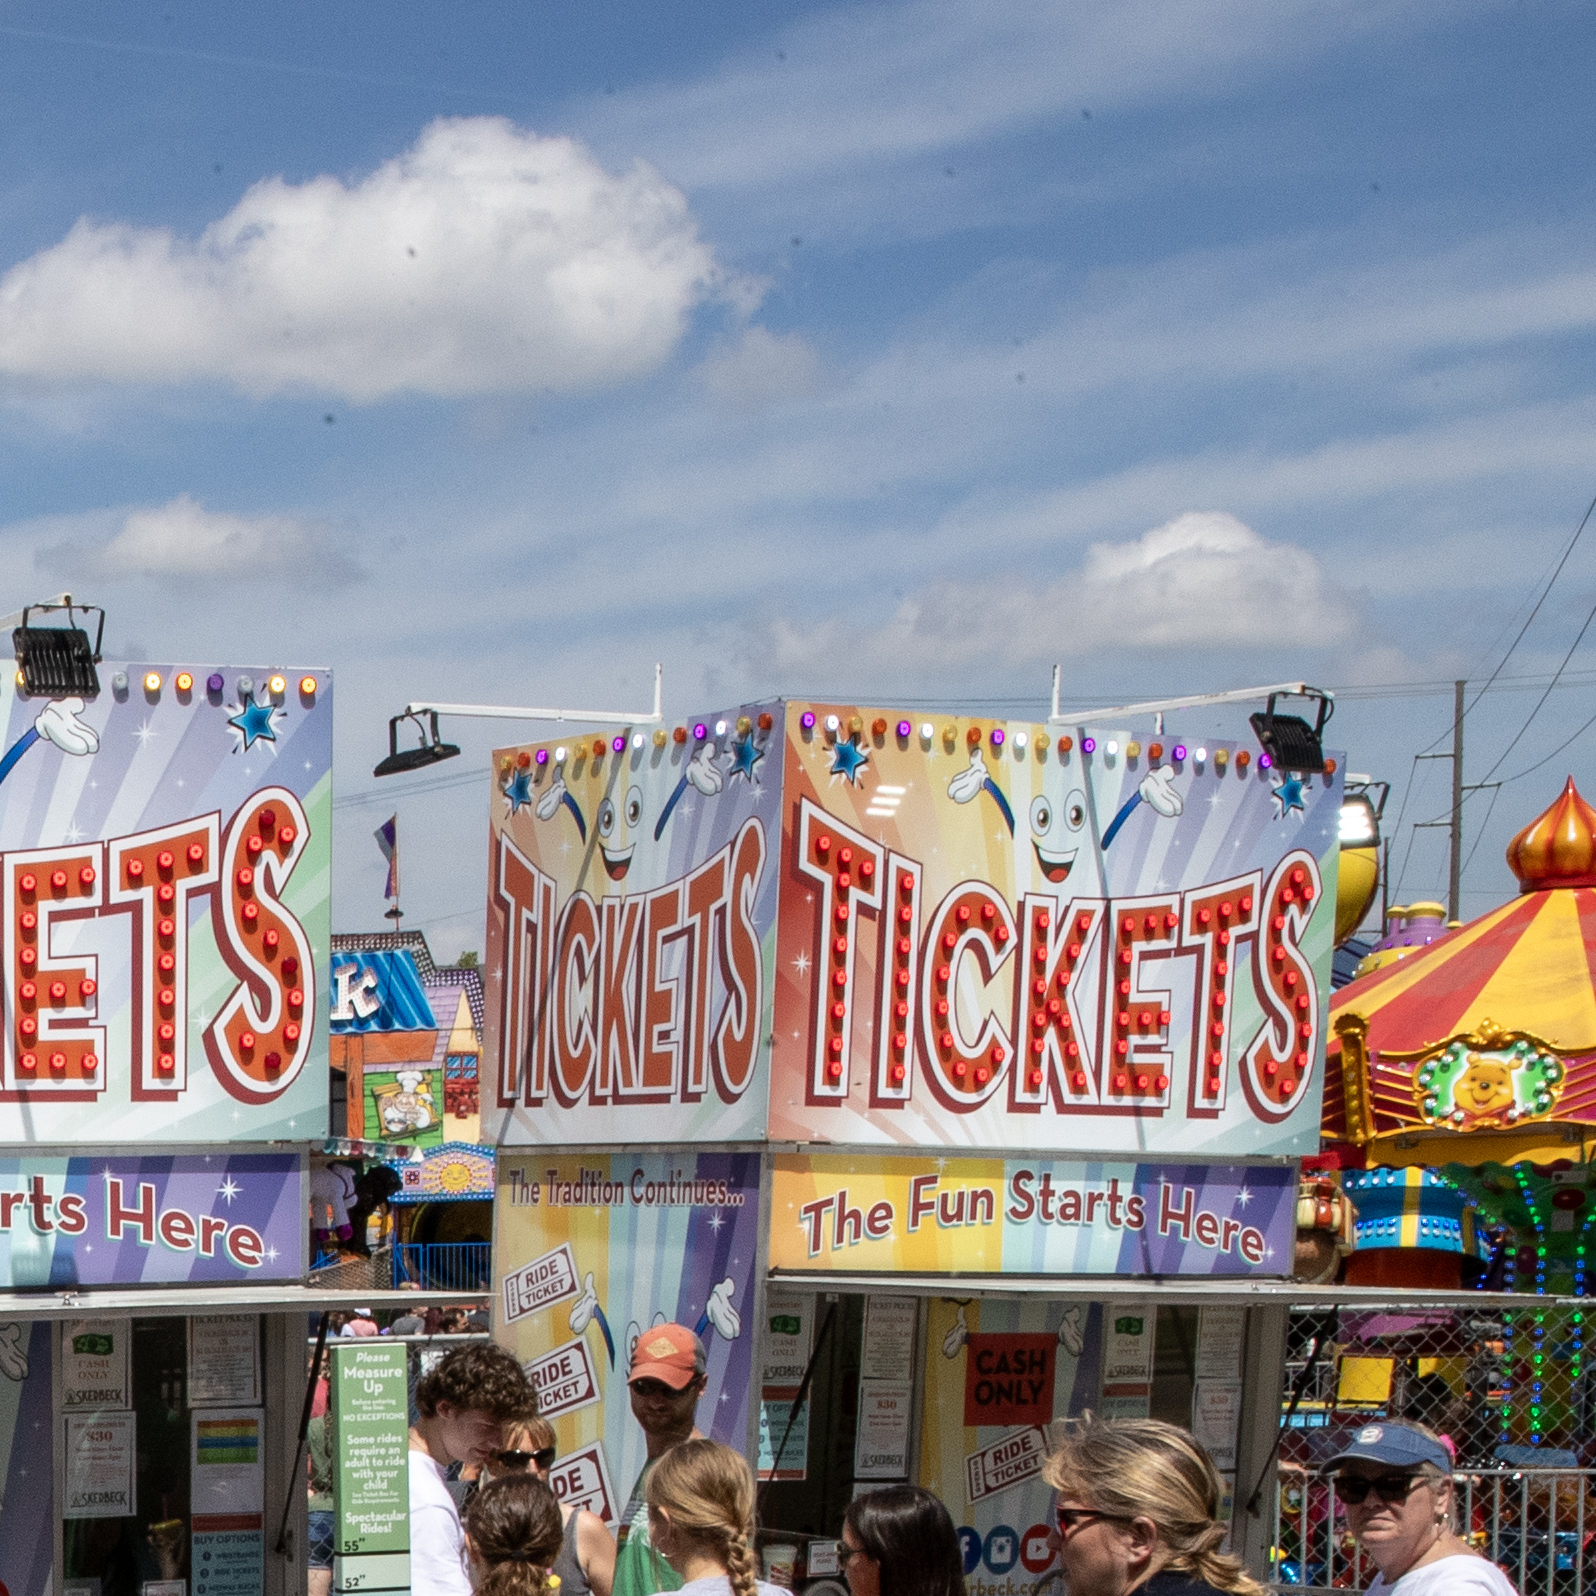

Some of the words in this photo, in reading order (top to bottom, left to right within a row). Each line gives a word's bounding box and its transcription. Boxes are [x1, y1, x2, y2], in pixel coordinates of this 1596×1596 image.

[492, 816, 767, 1110] TICKETS
[791, 796, 1325, 1122] TICKETS
[509, 1170, 540, 1206] The
[546, 1167, 625, 1206] Tradition
[630, 1168, 746, 1207] Continues...
[108, 1176, 266, 1268] Here
[803, 1195, 894, 1259] The
[907, 1173, 995, 1235] Fun
[1006, 1169, 1144, 1231] Starts
[1156, 1180, 1266, 1265] Here
[525, 1259, 560, 1288] RIDE
[524, 1279, 565, 1306] TICKET
[78, 1360, 110, 1369] CASH
[356, 1352, 391, 1364] Please
[976, 1349, 1048, 1376] CASH
[78, 1370, 110, 1380] ONLY
[343, 1366, 403, 1380] Measure
[531, 1355, 574, 1388] RIDE
[75, 1388, 123, 1404] SKERBECK
[363, 1380, 384, 1396] Up
[539, 1380, 580, 1406] ICKET
[975, 1377, 1049, 1409] ONLY
[343, 1413, 356, 1422] NO
[356, 1412, 406, 1422] EXCEPTIONS
[347, 1434, 375, 1446] Some
[376, 1432, 403, 1444] rides
[349, 1447, 387, 1459] require
[388, 1447, 401, 1456] an
[992, 1434, 1033, 1467] RIDE
[344, 1456, 370, 1468] adult
[372, 1456, 384, 1467] to
[385, 1456, 406, 1467] ride
[992, 1454, 1040, 1484] TICKET
[351, 1469, 374, 1479] with
[375, 1470, 399, 1482] your
[554, 1465, 584, 1497] DE
[363, 1479, 388, 1490] child
[345, 1510, 407, 1526] Spectacular
[360, 1521, 393, 1535] Rides!
[193, 1535, 215, 1545] BUY
[216, 1533, 261, 1545] OPTIONS
